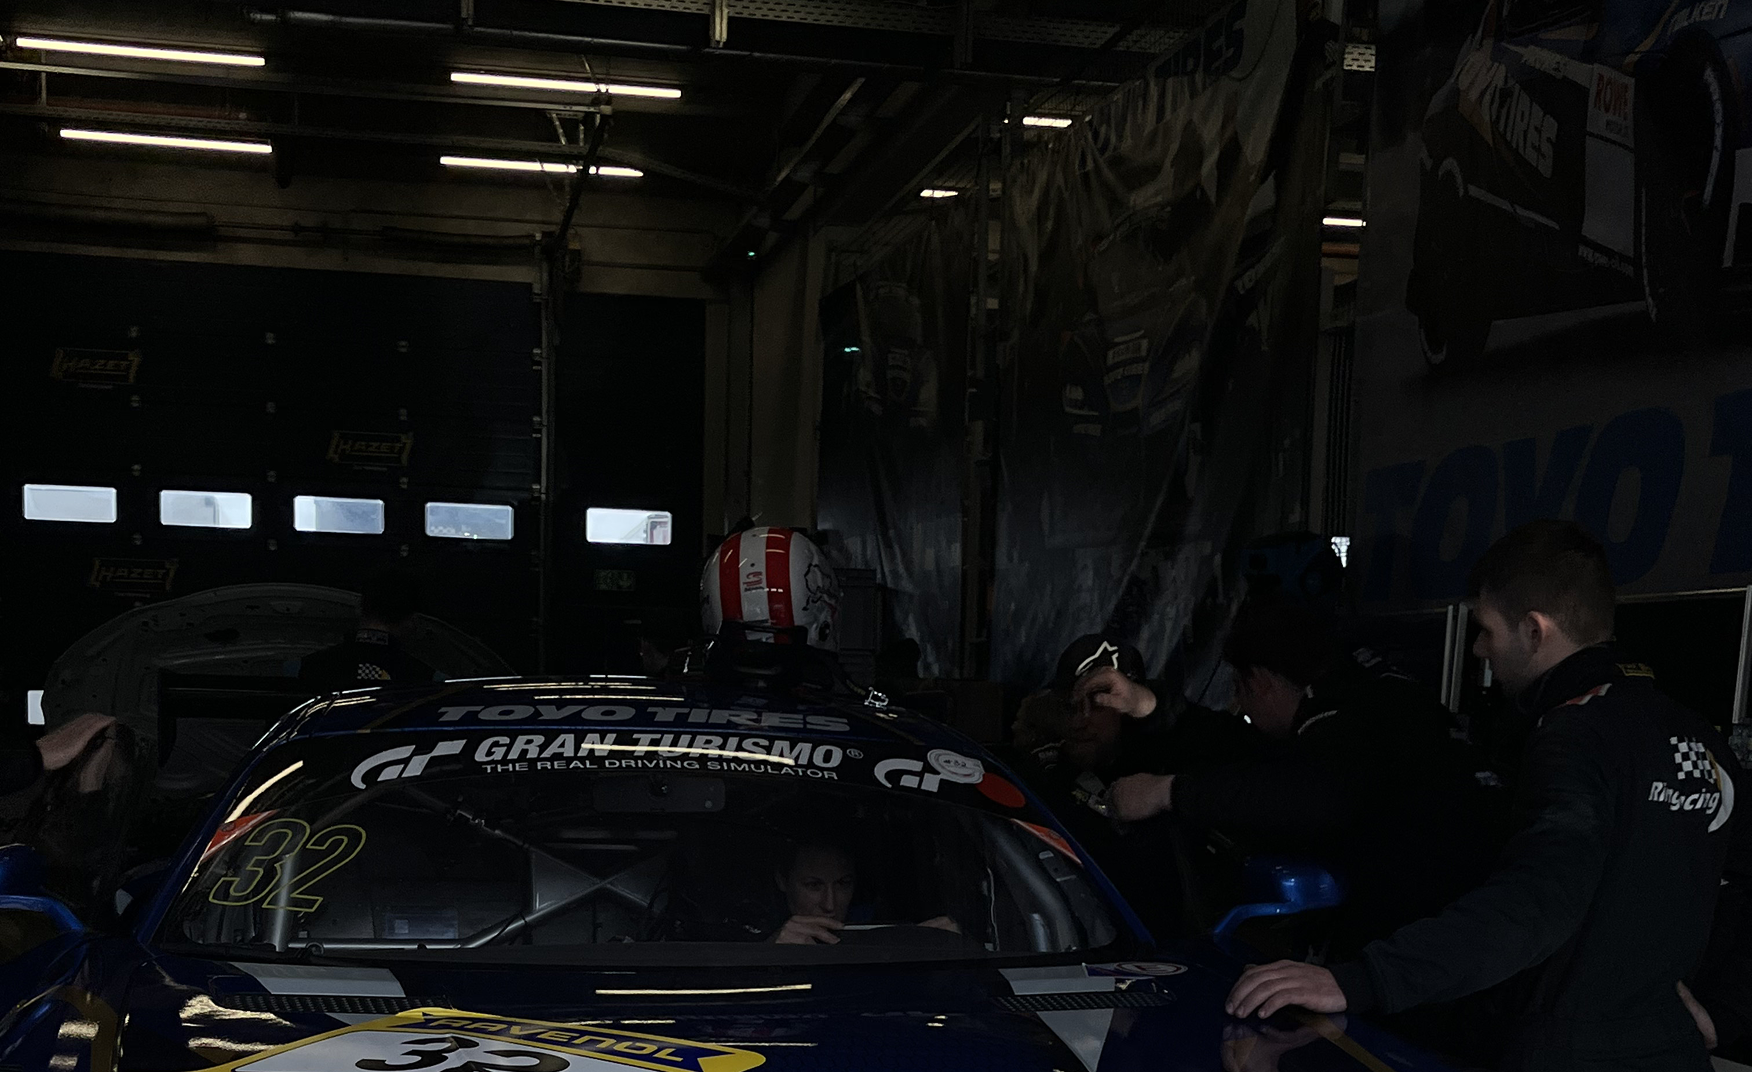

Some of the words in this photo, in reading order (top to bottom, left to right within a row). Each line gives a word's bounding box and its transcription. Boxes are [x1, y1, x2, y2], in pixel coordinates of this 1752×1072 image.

[60, 355, 131, 374] HAZET
[338, 438, 404, 456] HAZET
[1362, 405, 1686, 601] TOYO
[99, 566, 168, 583] HAZET
[437, 704, 637, 722] TOYO
[647, 707, 851, 732] TIRES
[473, 732, 617, 763] GRAN
[481, 762, 530, 774] THE
[537, 759, 599, 771] REAL
[604, 759, 701, 770] DRIVING
[707, 760, 840, 781] SIMULATOR
[208, 817, 368, 913] 32
[428, 1018, 685, 1063] RAVENOL
